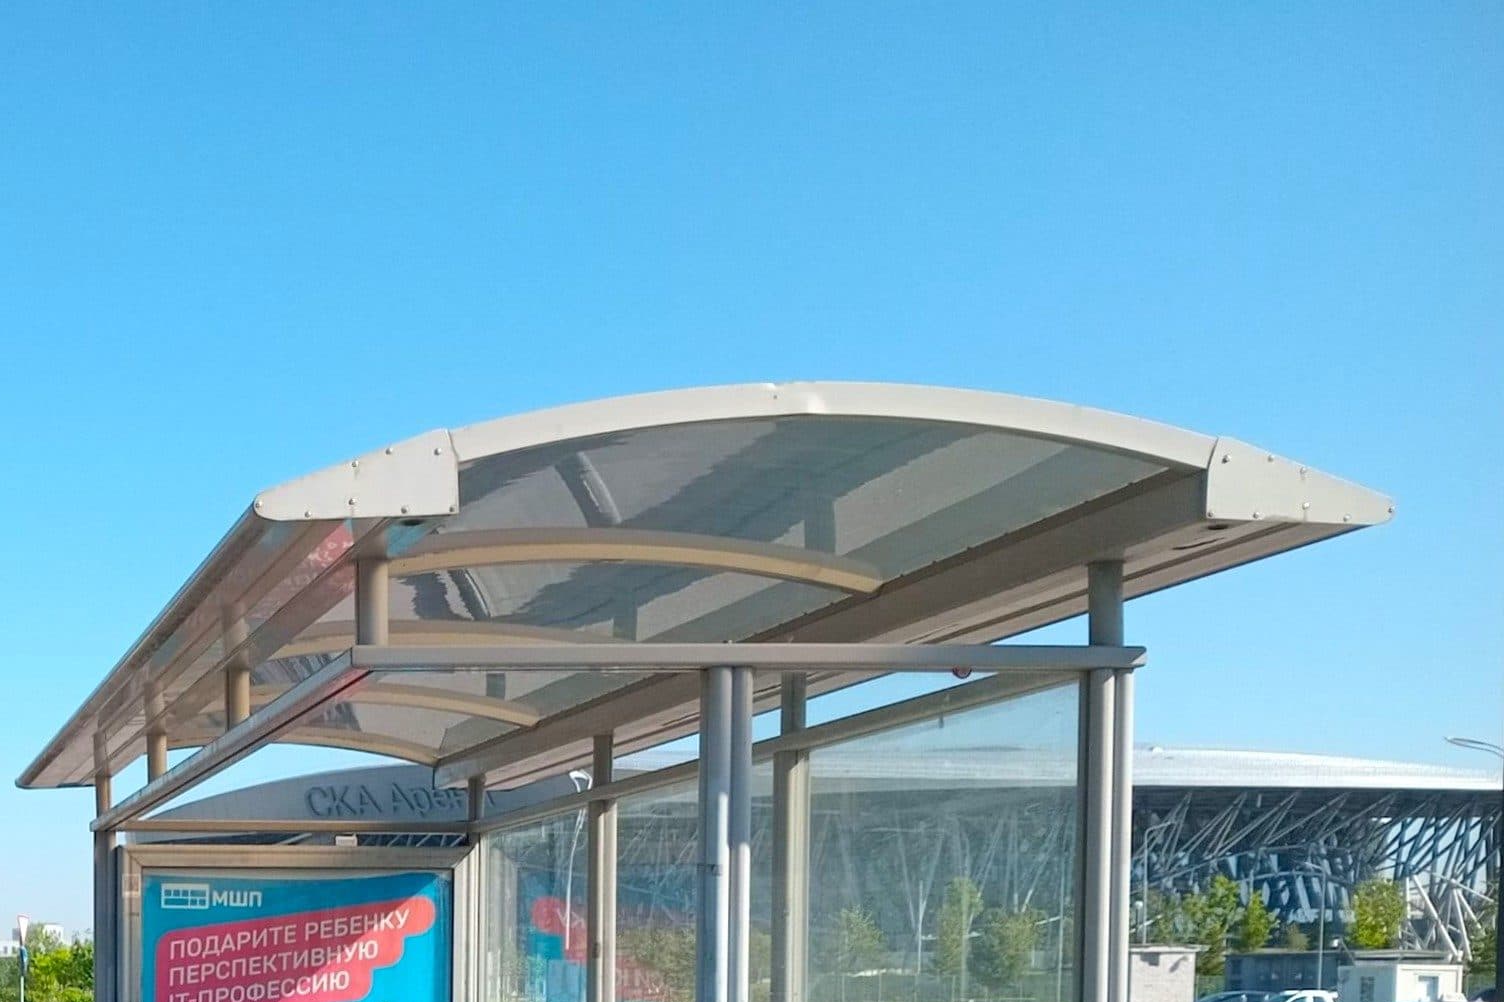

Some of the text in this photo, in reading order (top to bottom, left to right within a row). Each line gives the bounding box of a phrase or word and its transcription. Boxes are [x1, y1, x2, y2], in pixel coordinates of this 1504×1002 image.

[303, 782, 495, 818] СКА Арен
[212, 890, 262, 908] МШП
[169, 909, 410, 960] ПОДАРИТЕ РЕБЕНКУ
[169, 940, 379, 987] ПЕРСПЕКТИВНУЮ
